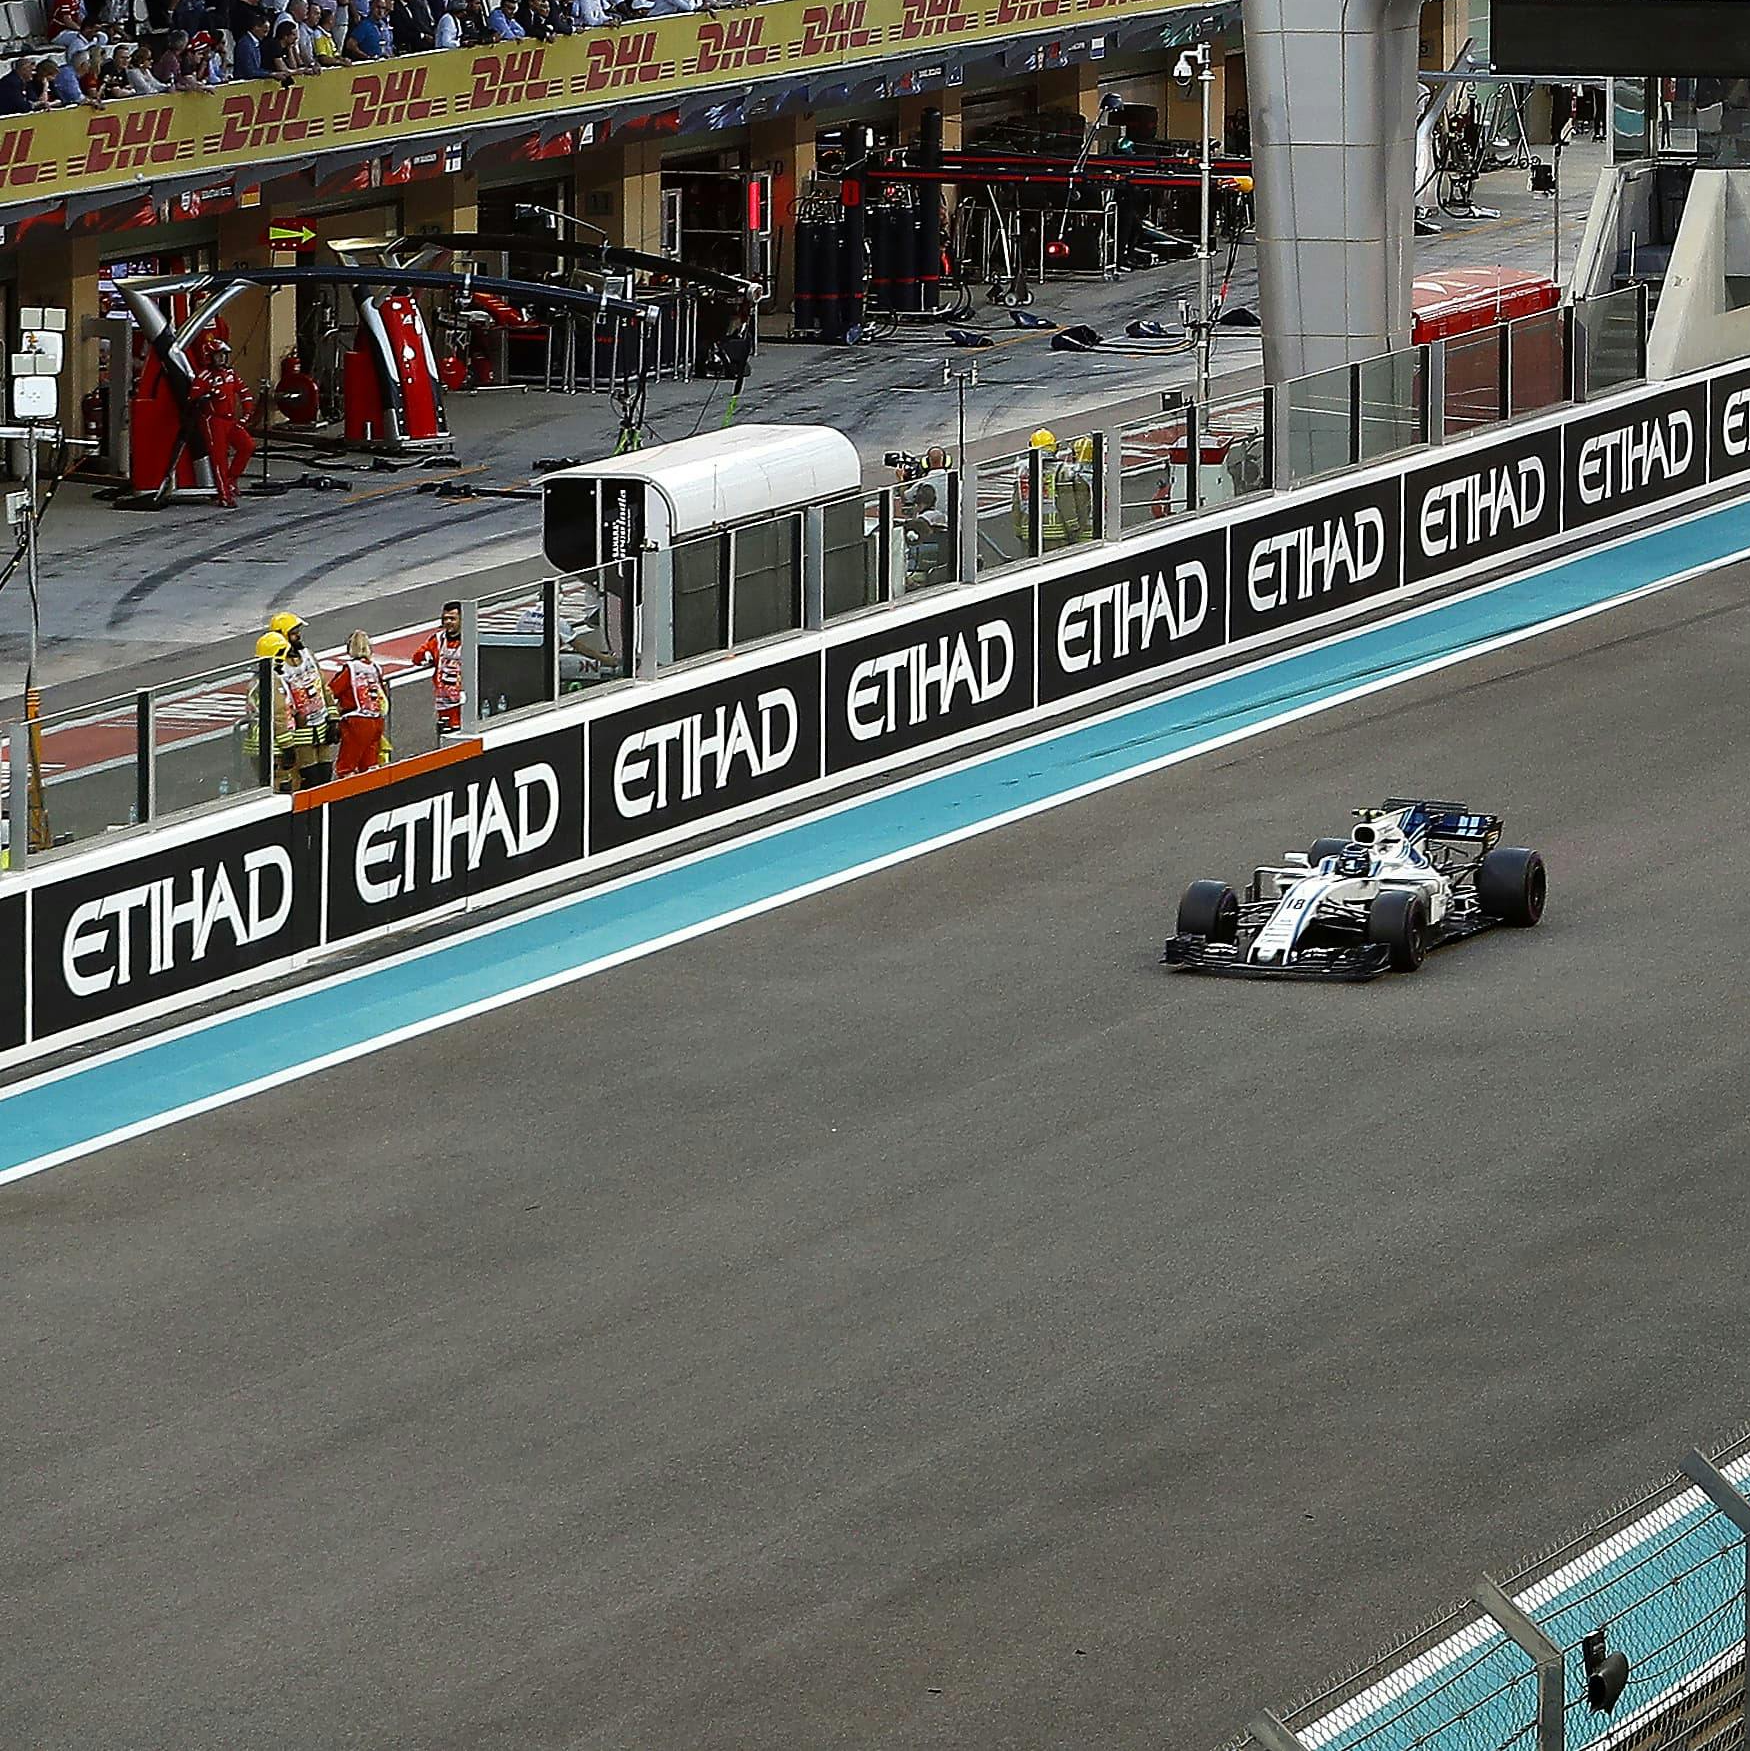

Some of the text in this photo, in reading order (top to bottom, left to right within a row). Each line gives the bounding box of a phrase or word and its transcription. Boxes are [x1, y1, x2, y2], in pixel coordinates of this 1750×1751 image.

[585, 32, 661, 93] DHL
[696, 15, 769, 75] DHL
[800, 0, 871, 58] DHL
[220, 86, 310, 152] DHL
[348, 66, 432, 131] DHL
[469, 48, 550, 110] DHL
[84, 106, 179, 174] DHL
[1578, 409, 1695, 505] ETIHAD
[1420, 454, 1545, 557] ETIHAD
[1248, 506, 1386, 613] ETIHAD
[1057, 559, 1209, 673] ETIHAD
[846, 618, 1015, 742] ETIHAD
[612, 686, 799, 819] ETIHAD
[354, 761, 561, 904] ETIHAD
[62, 844, 294, 998] ETIHAD
[1286, 898, 1304, 910] 18
